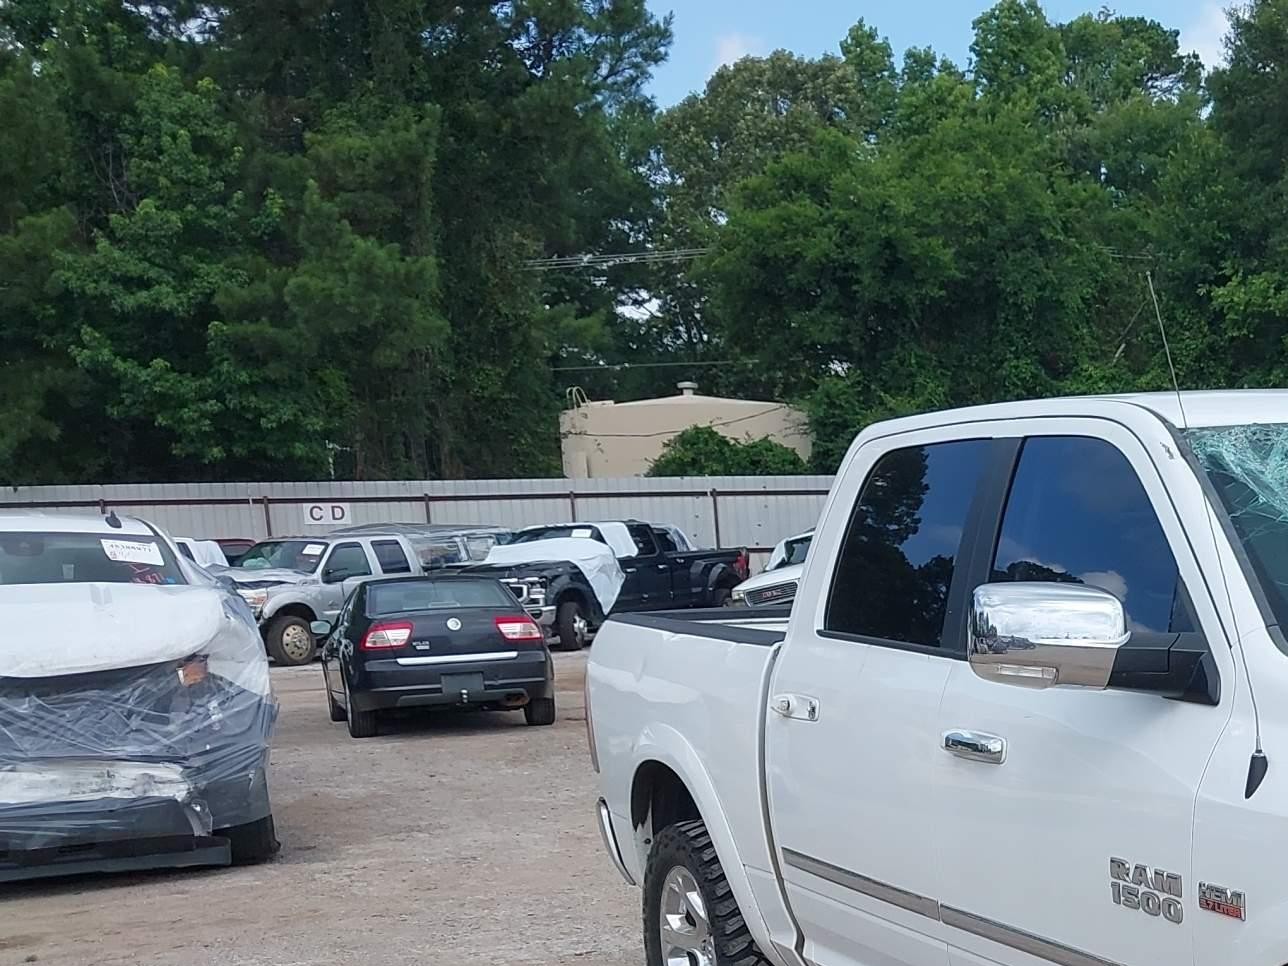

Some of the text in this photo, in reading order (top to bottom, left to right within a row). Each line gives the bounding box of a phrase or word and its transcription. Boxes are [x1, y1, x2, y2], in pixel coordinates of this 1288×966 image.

[309, 505, 345, 521] C D
[1109, 856, 1183, 898] RAM
[1110, 880, 1184, 925] 1500
[1199, 882, 1246, 911] HEMI
